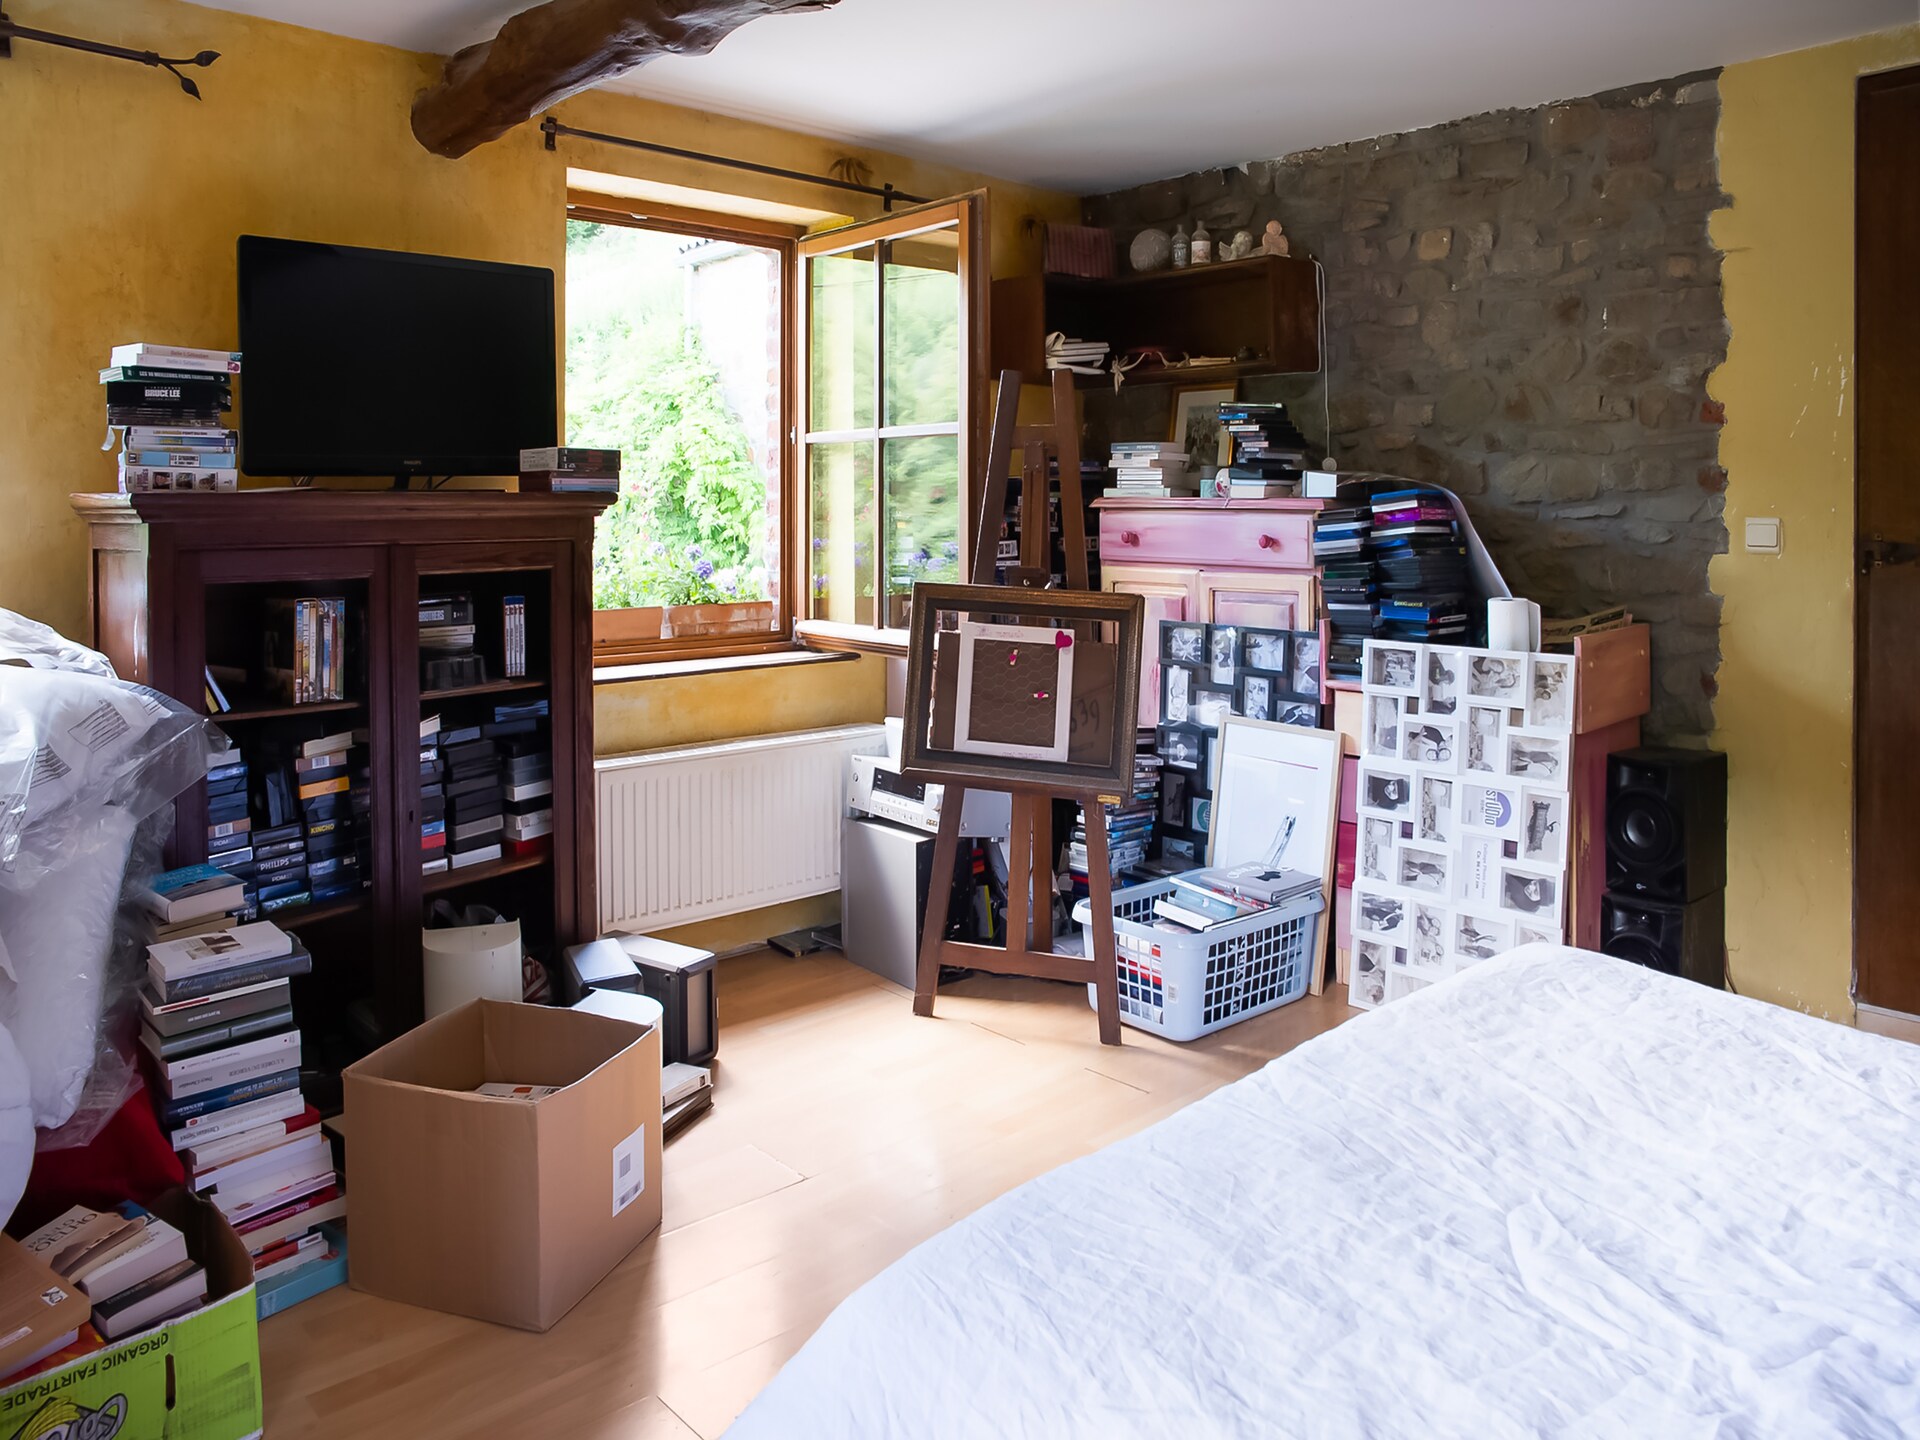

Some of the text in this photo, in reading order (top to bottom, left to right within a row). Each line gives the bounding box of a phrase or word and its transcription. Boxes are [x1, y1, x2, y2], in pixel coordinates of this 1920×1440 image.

[145, 389, 181, 397] BRUCE LEE
[1485, 790, 1502, 825] STUDIO
[260, 857, 290, 871] PHILIPS
[196, 1125, 220, 1139] Christian
[294, 1201, 310, 1212] DSK
[27, 1218, 76, 1250] PAULO
[35, 1213, 98, 1253] OELHO
[2, 1332, 169, 1411] ORGANIC FAIRTRADE
